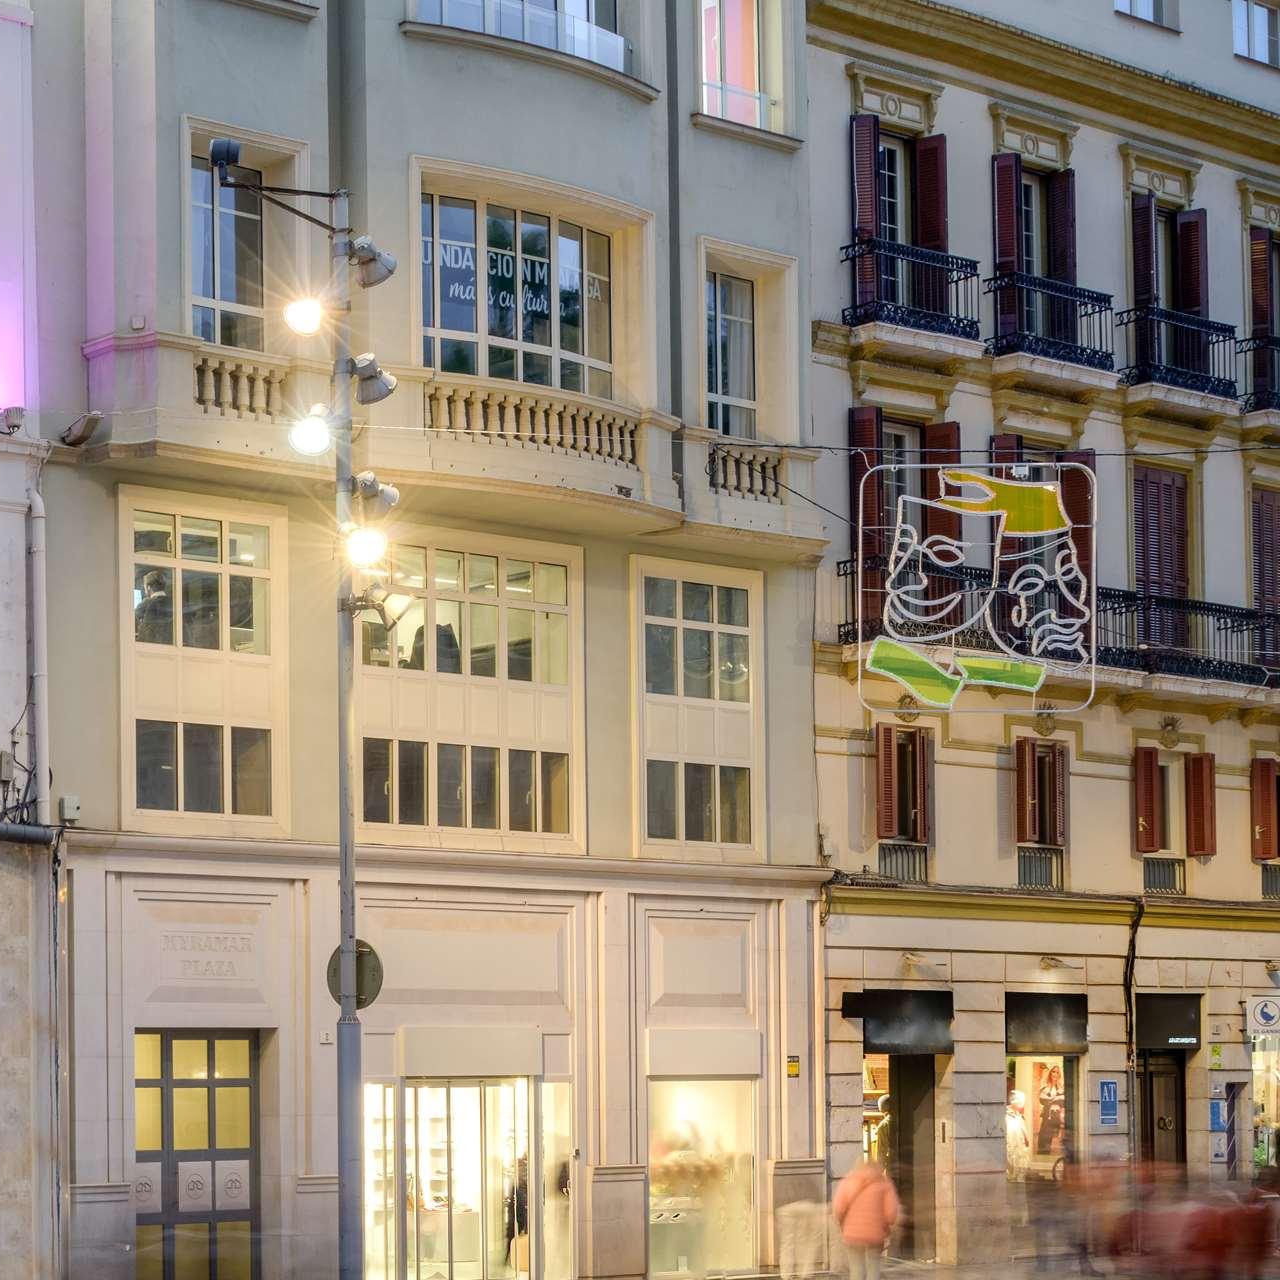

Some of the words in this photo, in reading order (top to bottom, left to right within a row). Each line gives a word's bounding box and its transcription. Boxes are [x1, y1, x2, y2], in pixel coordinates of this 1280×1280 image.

[422, 239, 531, 282] UNDACIÓN
[180, 959, 237, 977] PLAZA
[1101, 1083, 1116, 1102] AT
